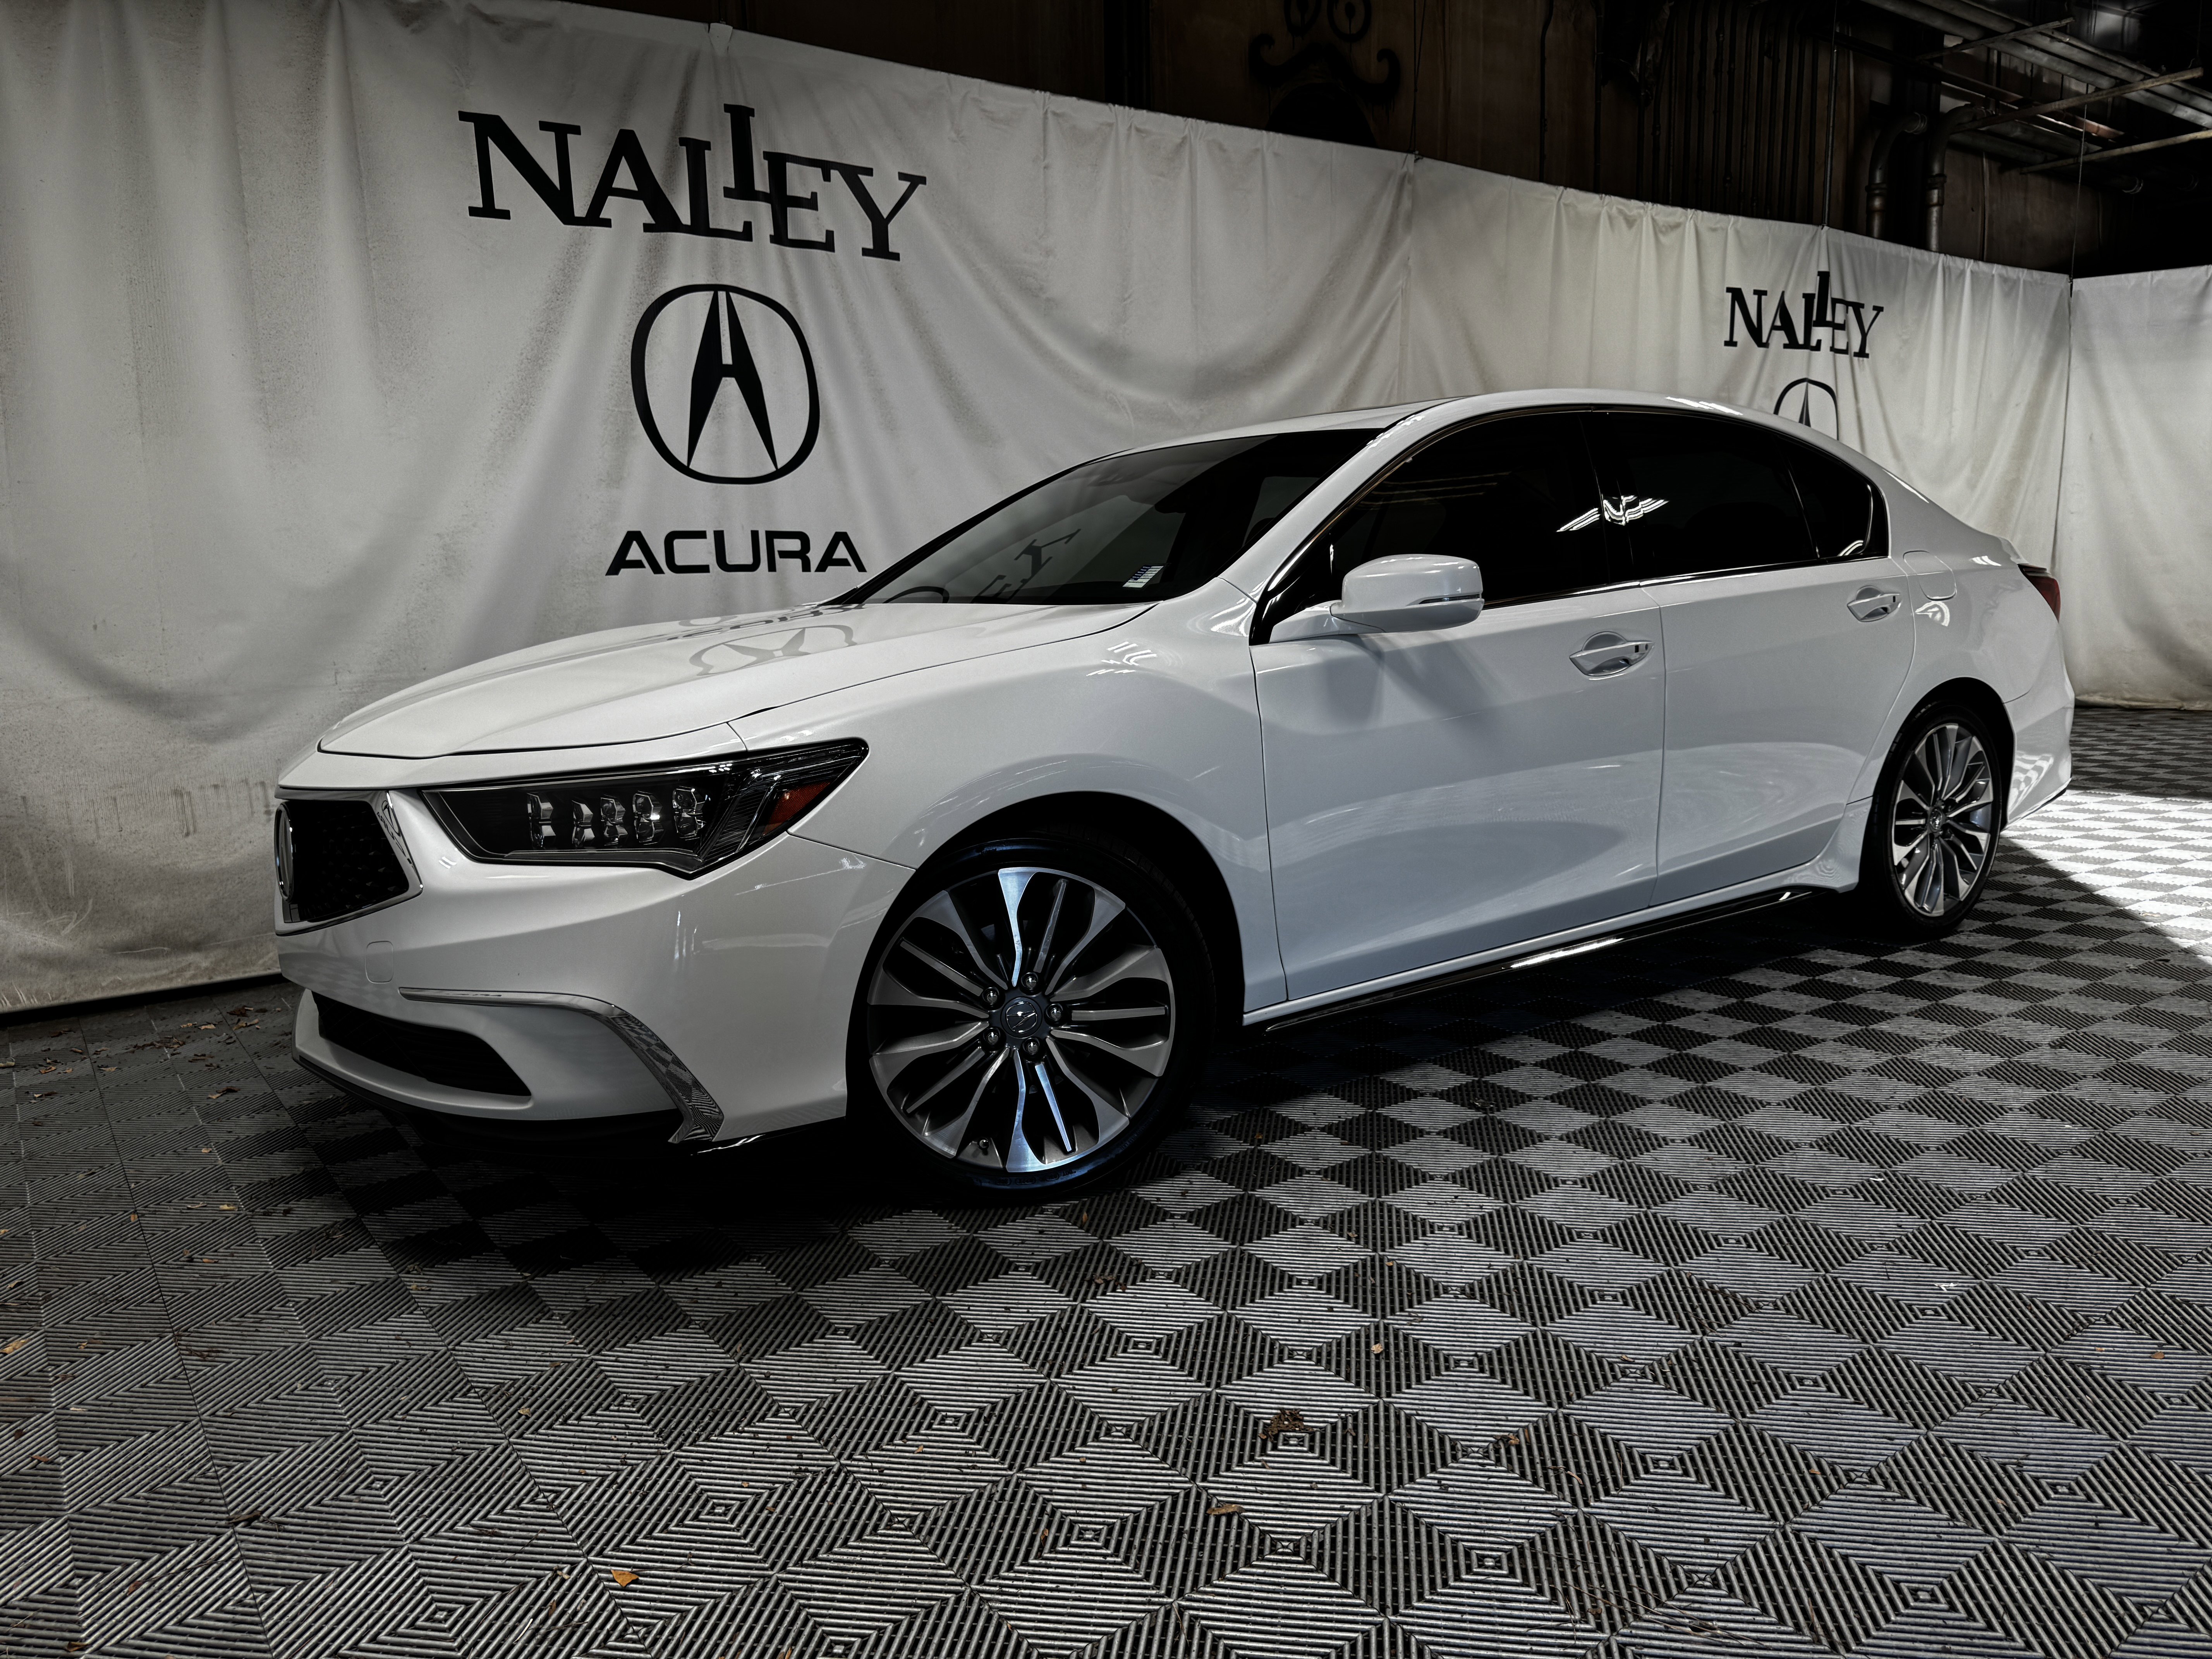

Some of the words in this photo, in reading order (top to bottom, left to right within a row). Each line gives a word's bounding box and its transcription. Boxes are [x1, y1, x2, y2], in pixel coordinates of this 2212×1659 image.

[458, 103, 927, 261] NALLEY
[1724, 271, 1884, 359] NALLEY
[605, 529, 867, 576] ACURA
